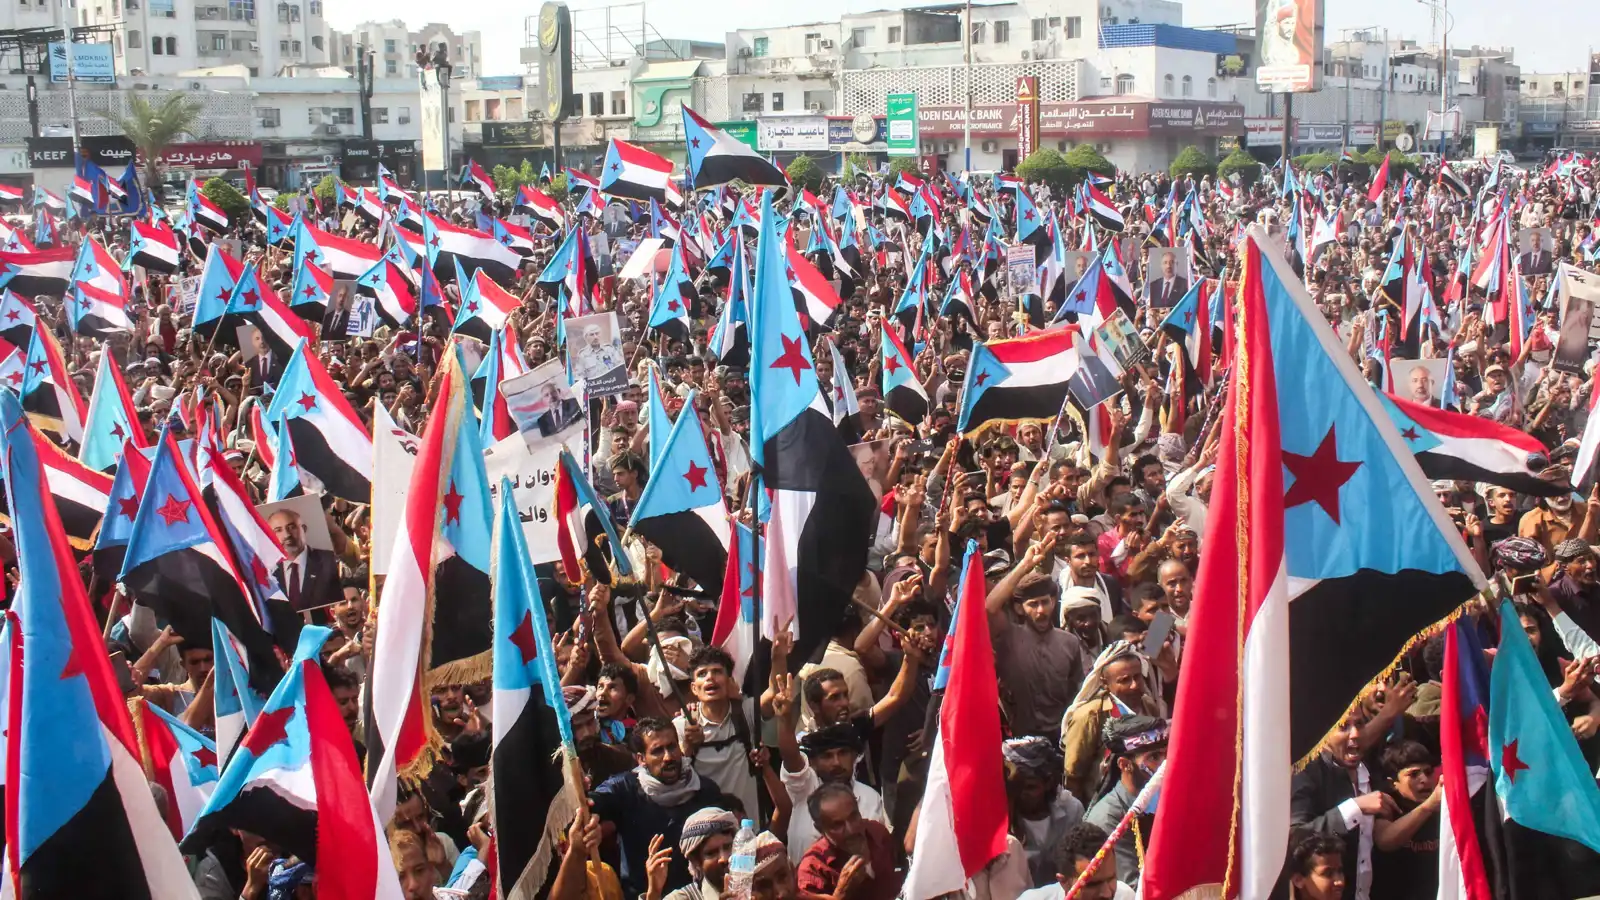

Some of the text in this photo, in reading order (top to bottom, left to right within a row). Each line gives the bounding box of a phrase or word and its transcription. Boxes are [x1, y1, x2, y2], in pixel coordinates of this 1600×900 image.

[918, 110, 941, 121] ADEN
[977, 109, 1003, 120] BANK
[1078, 107, 1105, 119] عدن
[1106, 105, 1134, 119] بنك
[767, 126, 795, 139] للتجارة
[33, 151, 67, 161] KEEF
[166, 152, 204, 165] بارك
[206, 152, 233, 165] هاي
